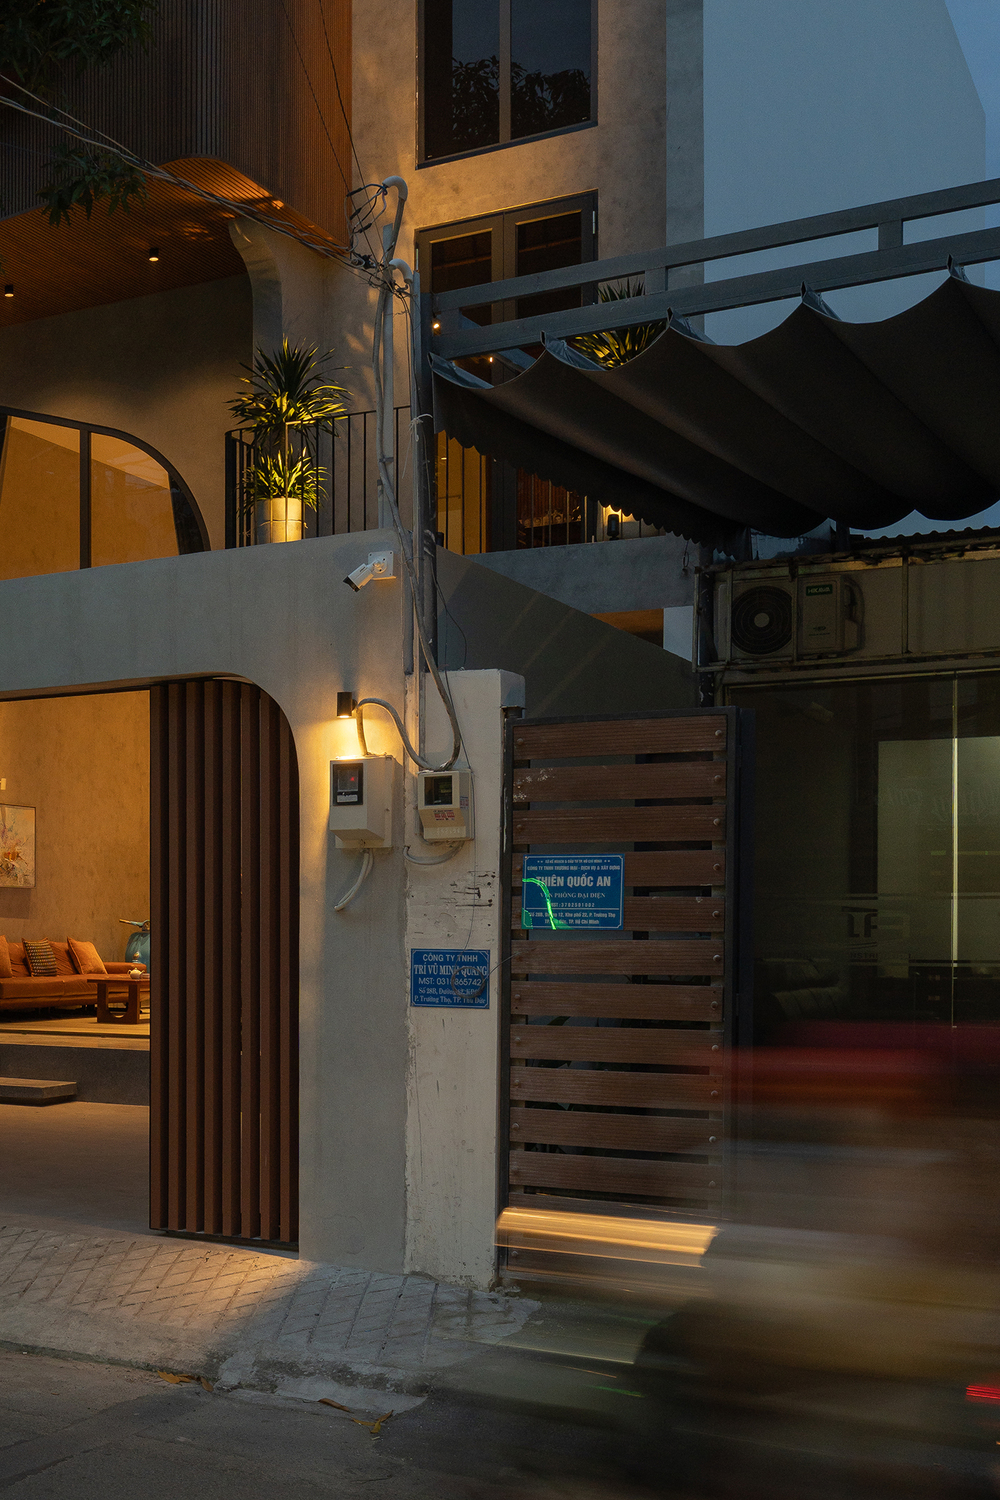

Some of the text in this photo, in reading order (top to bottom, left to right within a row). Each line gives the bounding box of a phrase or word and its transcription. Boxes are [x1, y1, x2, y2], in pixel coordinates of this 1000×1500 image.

[536, 873, 611, 888] THIÊN QUỐC AN
[423, 953, 444, 962] CÔNG
[446, 954, 455, 962] TY
[414, 962, 427, 975] TRÍ
[419, 977, 482, 986] MST: 031865742
